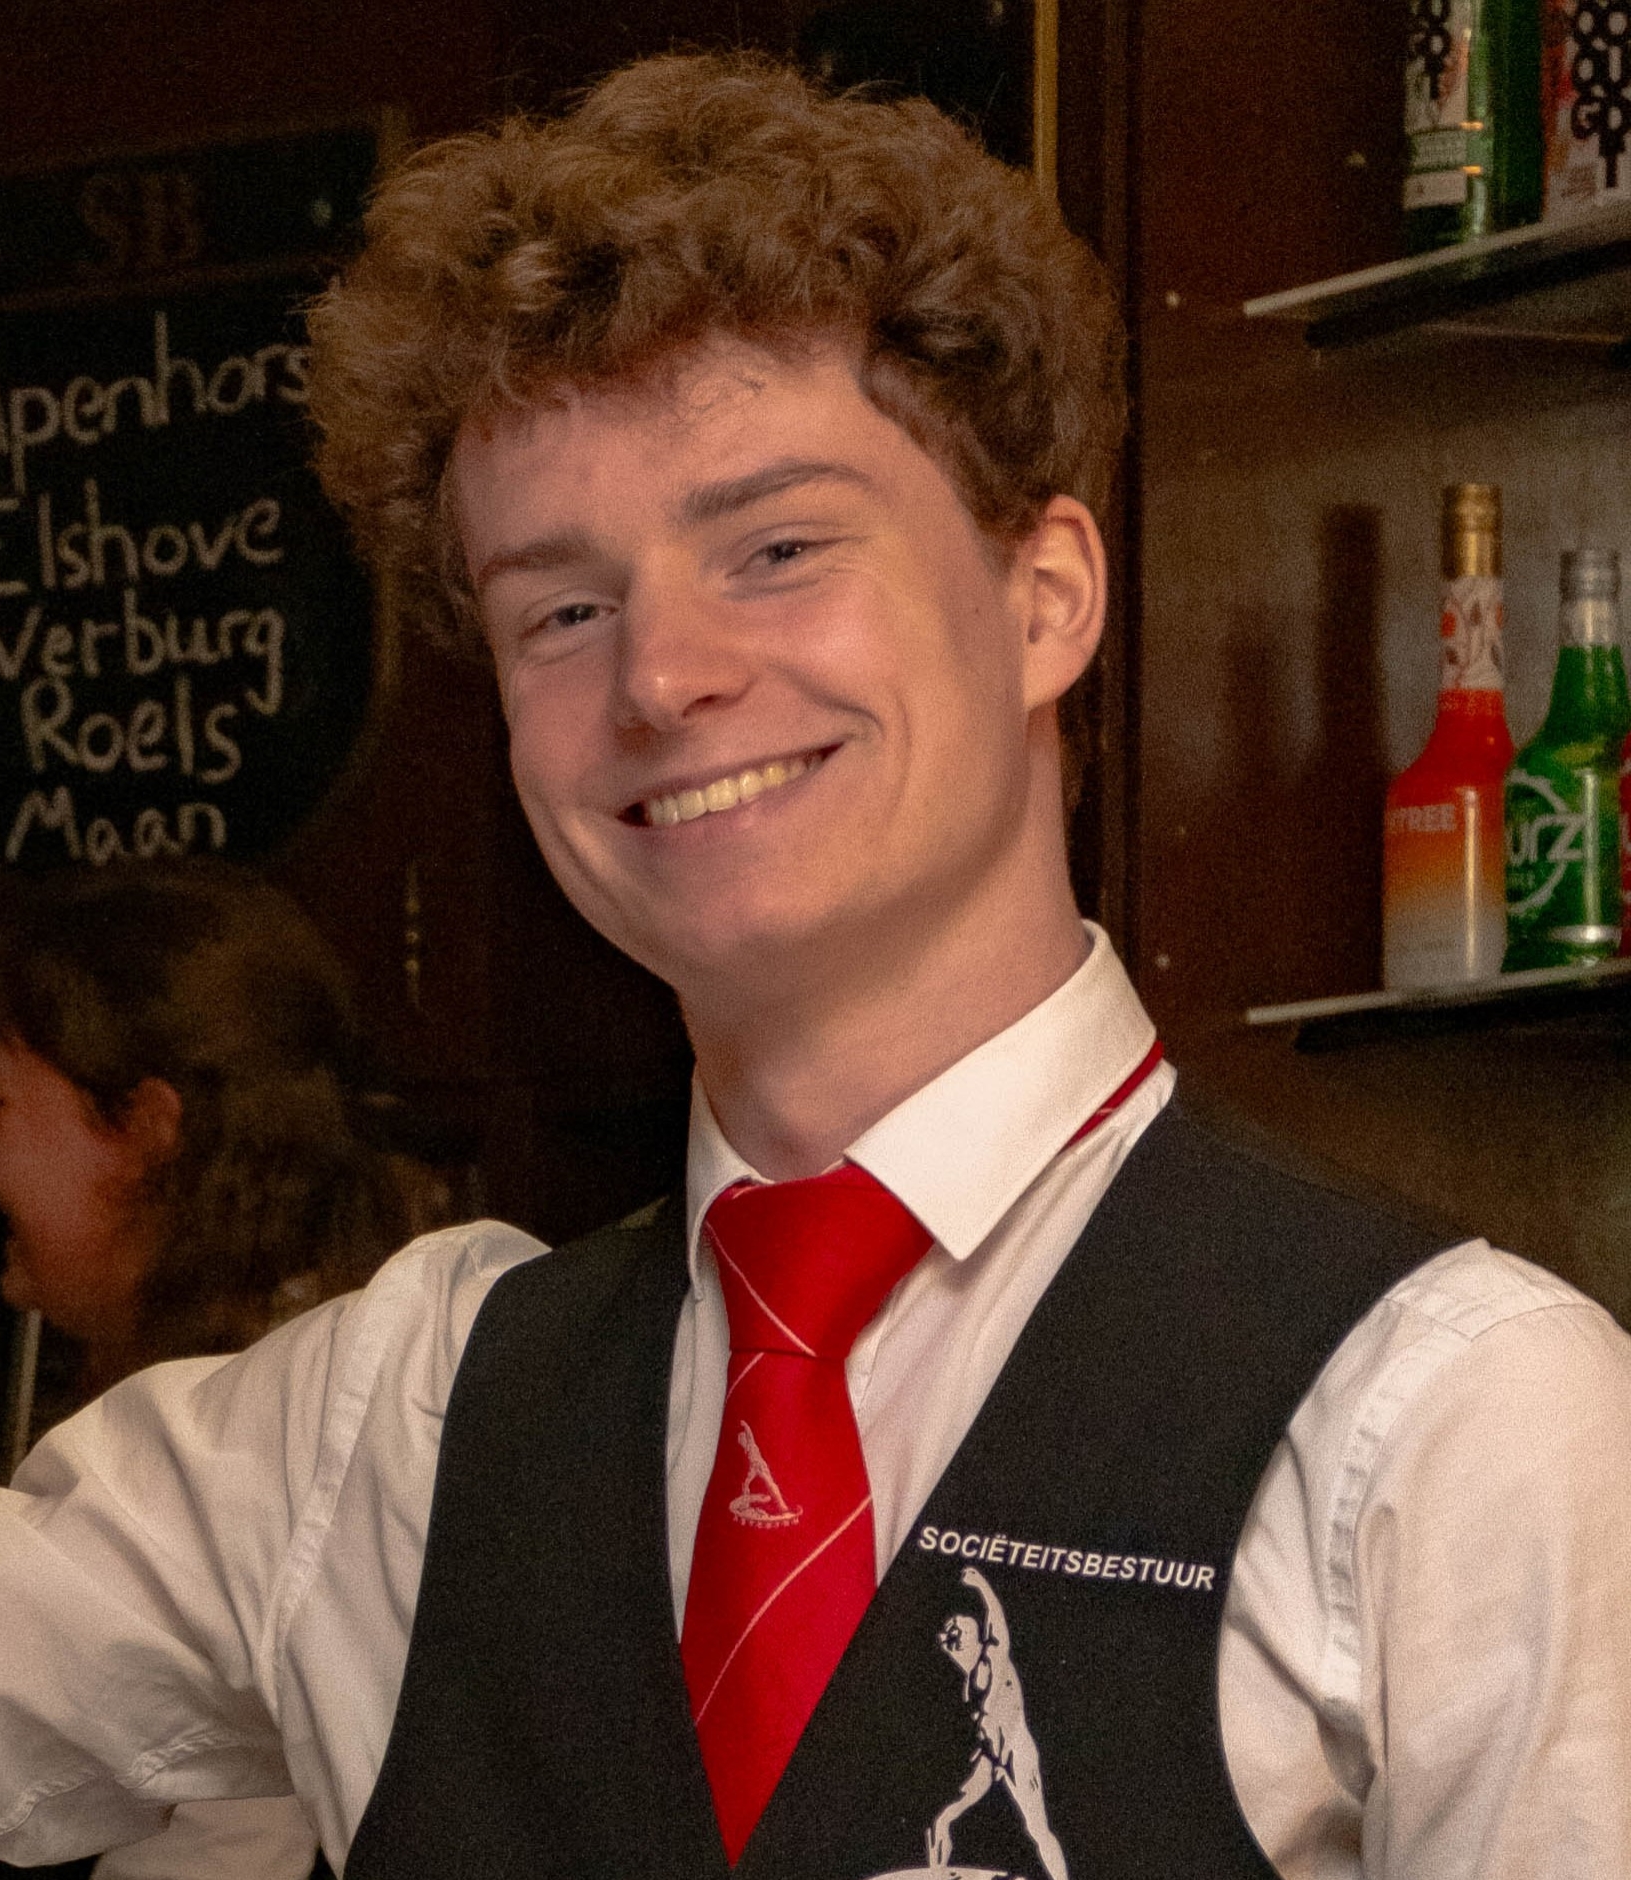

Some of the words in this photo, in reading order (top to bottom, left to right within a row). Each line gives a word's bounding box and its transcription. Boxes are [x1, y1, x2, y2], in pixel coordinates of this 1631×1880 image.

[20, 675, 243, 784] Roels
[5, 786, 226, 865] Maan
[1504, 813, 1588, 866] urz
[919, 1526, 1216, 1591] SOCIËTEITSBESTUUR
